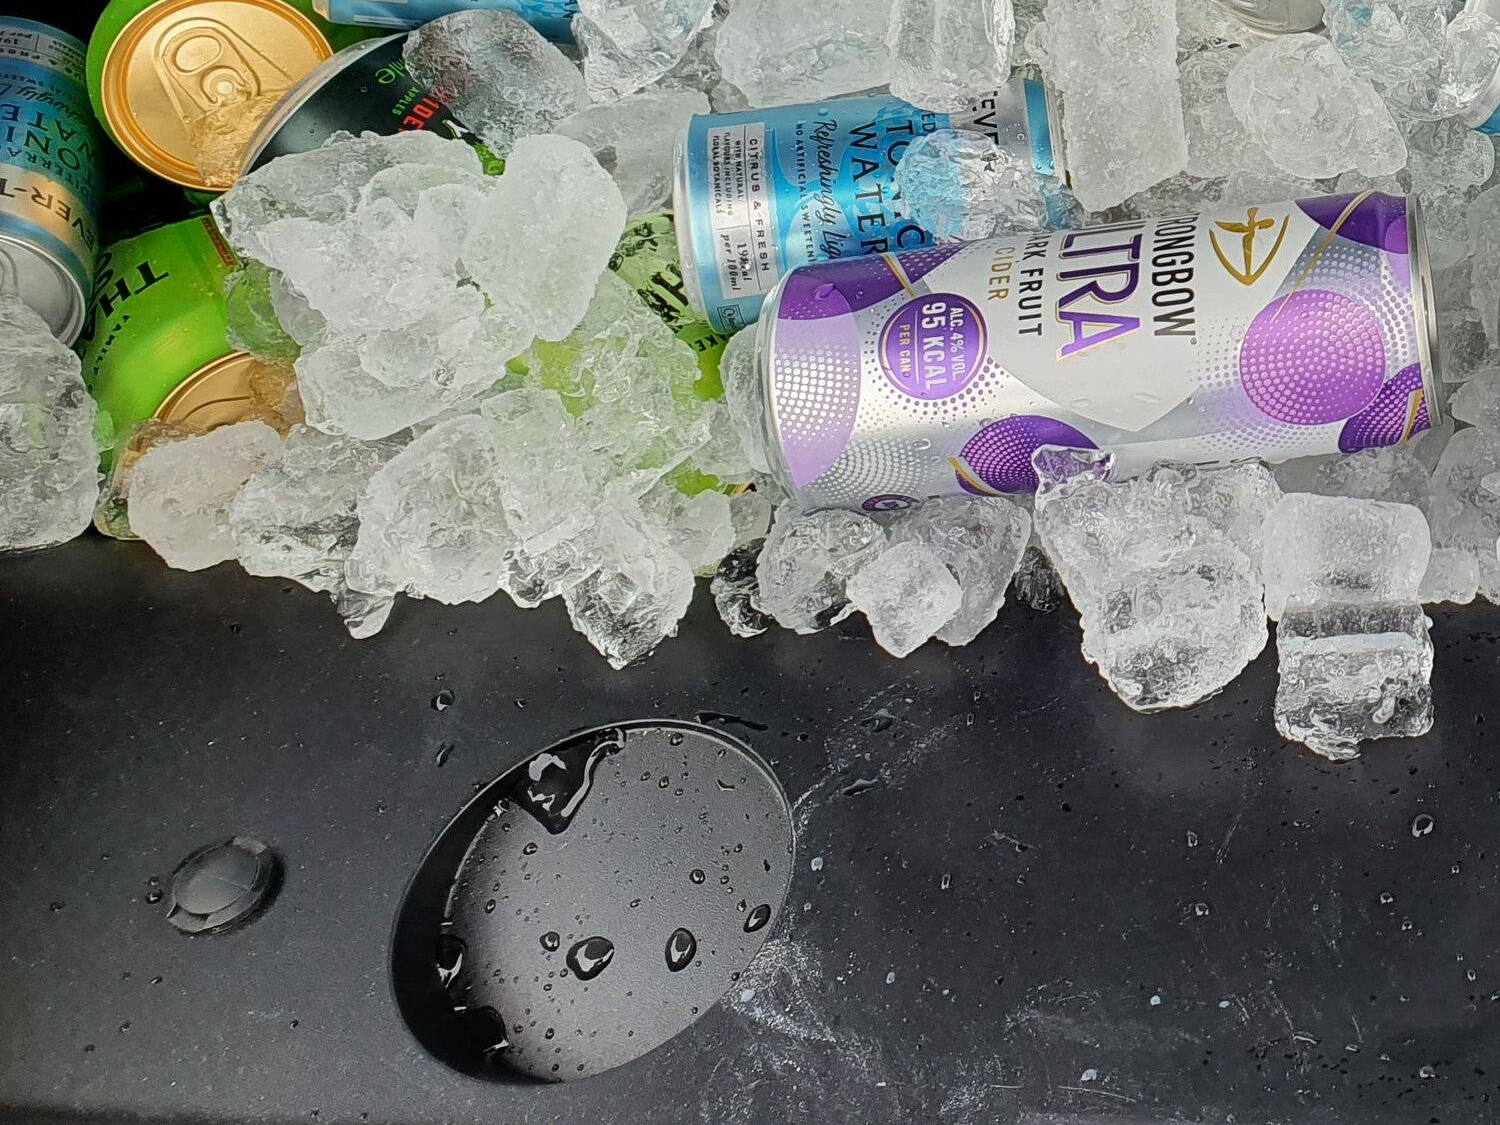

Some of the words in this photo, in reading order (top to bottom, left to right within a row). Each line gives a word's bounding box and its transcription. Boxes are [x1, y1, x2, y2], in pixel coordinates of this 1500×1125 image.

[795, 123, 803, 136] NO
[749, 138, 760, 193] CITRUS
[795, 137, 807, 199] ARTIFICIAL
[809, 119, 841, 225] Refreshingly
[848, 122, 888, 254] WATER
[753, 201, 762, 210] &
[720, 234, 731, 255] per
[727, 259, 742, 291] 100ml
[755, 219, 770, 271] FRESH
[987, 246, 1016, 302] CIDER
[921, 301, 946, 329] 95
[1017, 267, 1045, 338] FRUIT
[900, 323, 913, 352] PER
[922, 336, 948, 390] KCAL
[950, 332, 966, 352] 4%
[952, 355, 966, 379] VOL
